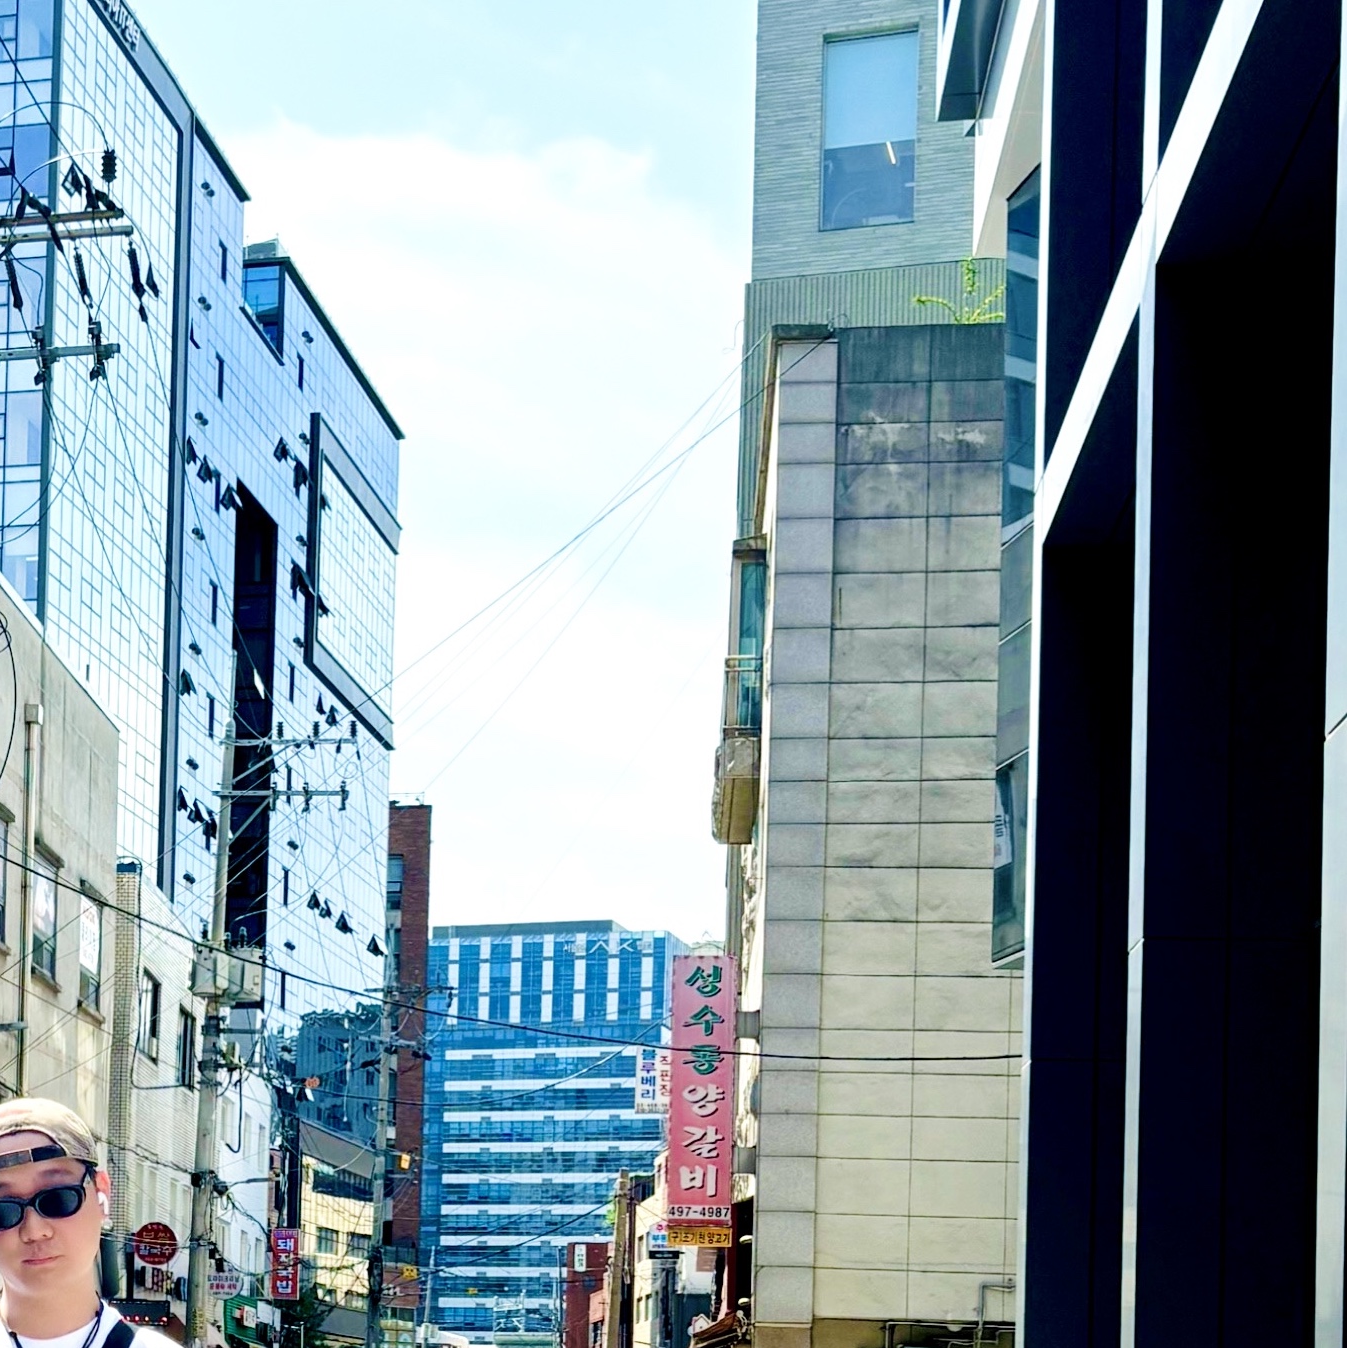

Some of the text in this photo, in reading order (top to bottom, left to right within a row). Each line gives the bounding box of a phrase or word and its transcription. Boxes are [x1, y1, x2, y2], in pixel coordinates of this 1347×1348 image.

[682, 965, 724, 1077] 성수동
[679, 1083, 725, 1198] 양갈비
[668, 1206, 730, 1218] 497-4987
